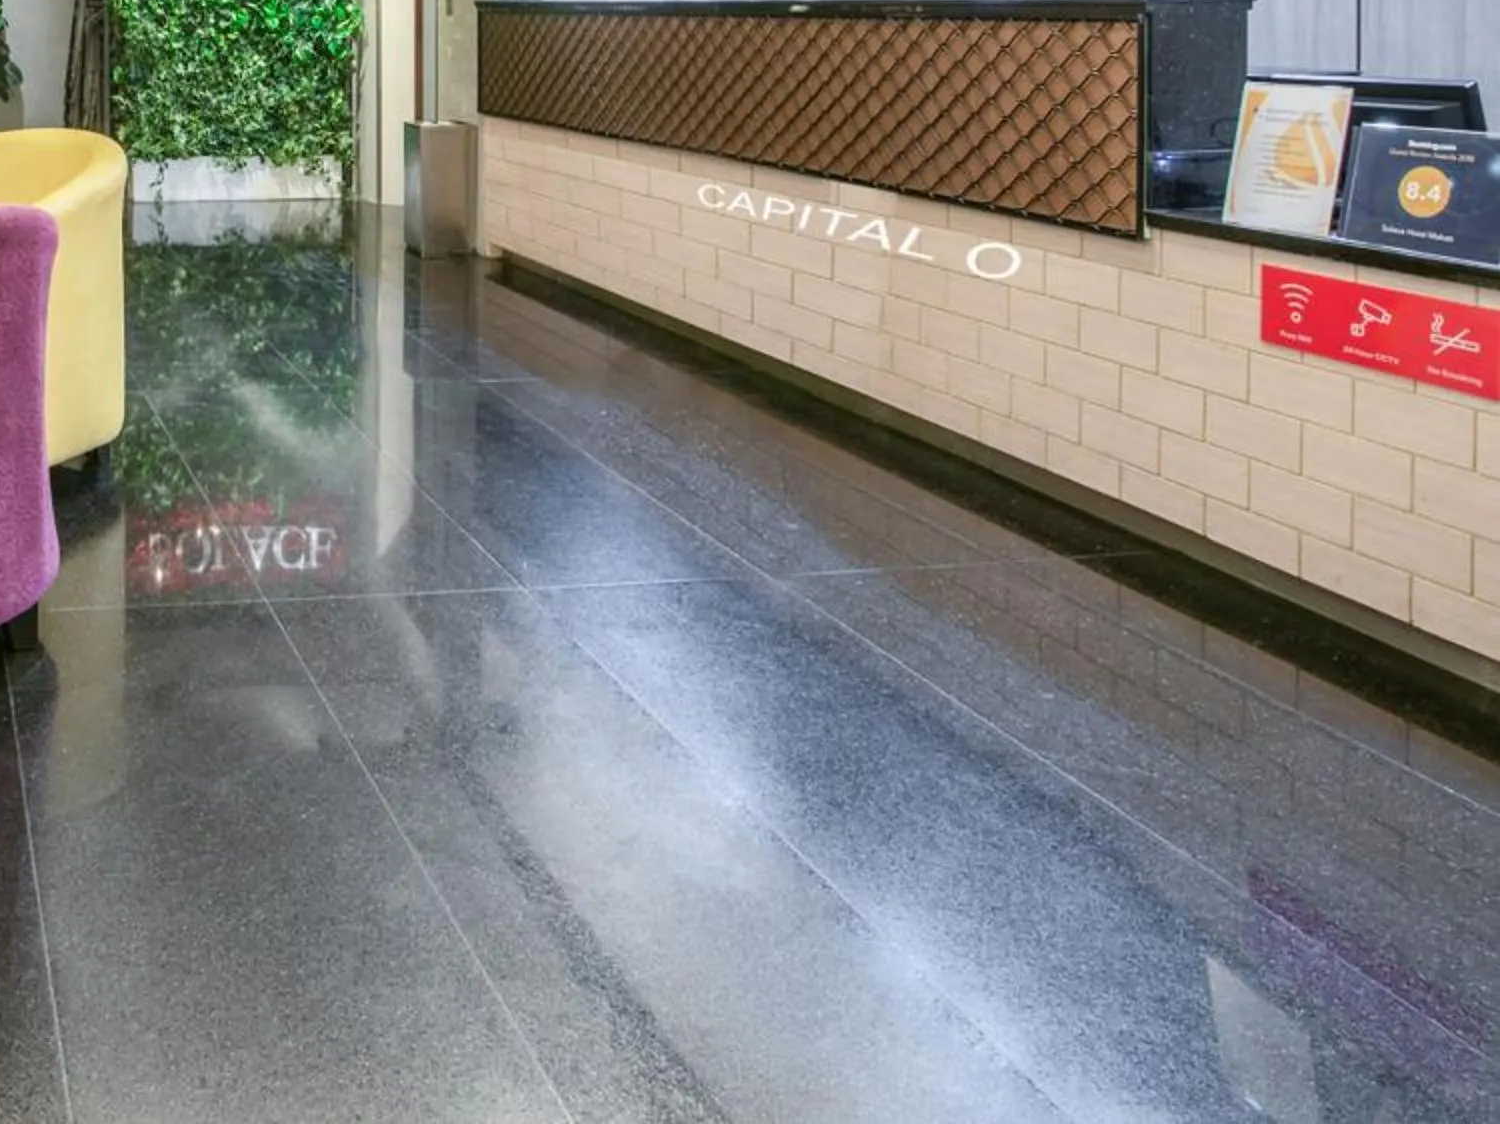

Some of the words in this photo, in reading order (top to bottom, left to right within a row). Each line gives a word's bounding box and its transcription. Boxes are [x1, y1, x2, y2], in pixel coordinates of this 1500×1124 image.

[1405, 180, 1442, 203] 8.4
[697, 184, 934, 261] CAPITAL
[966, 242, 1022, 280] O
